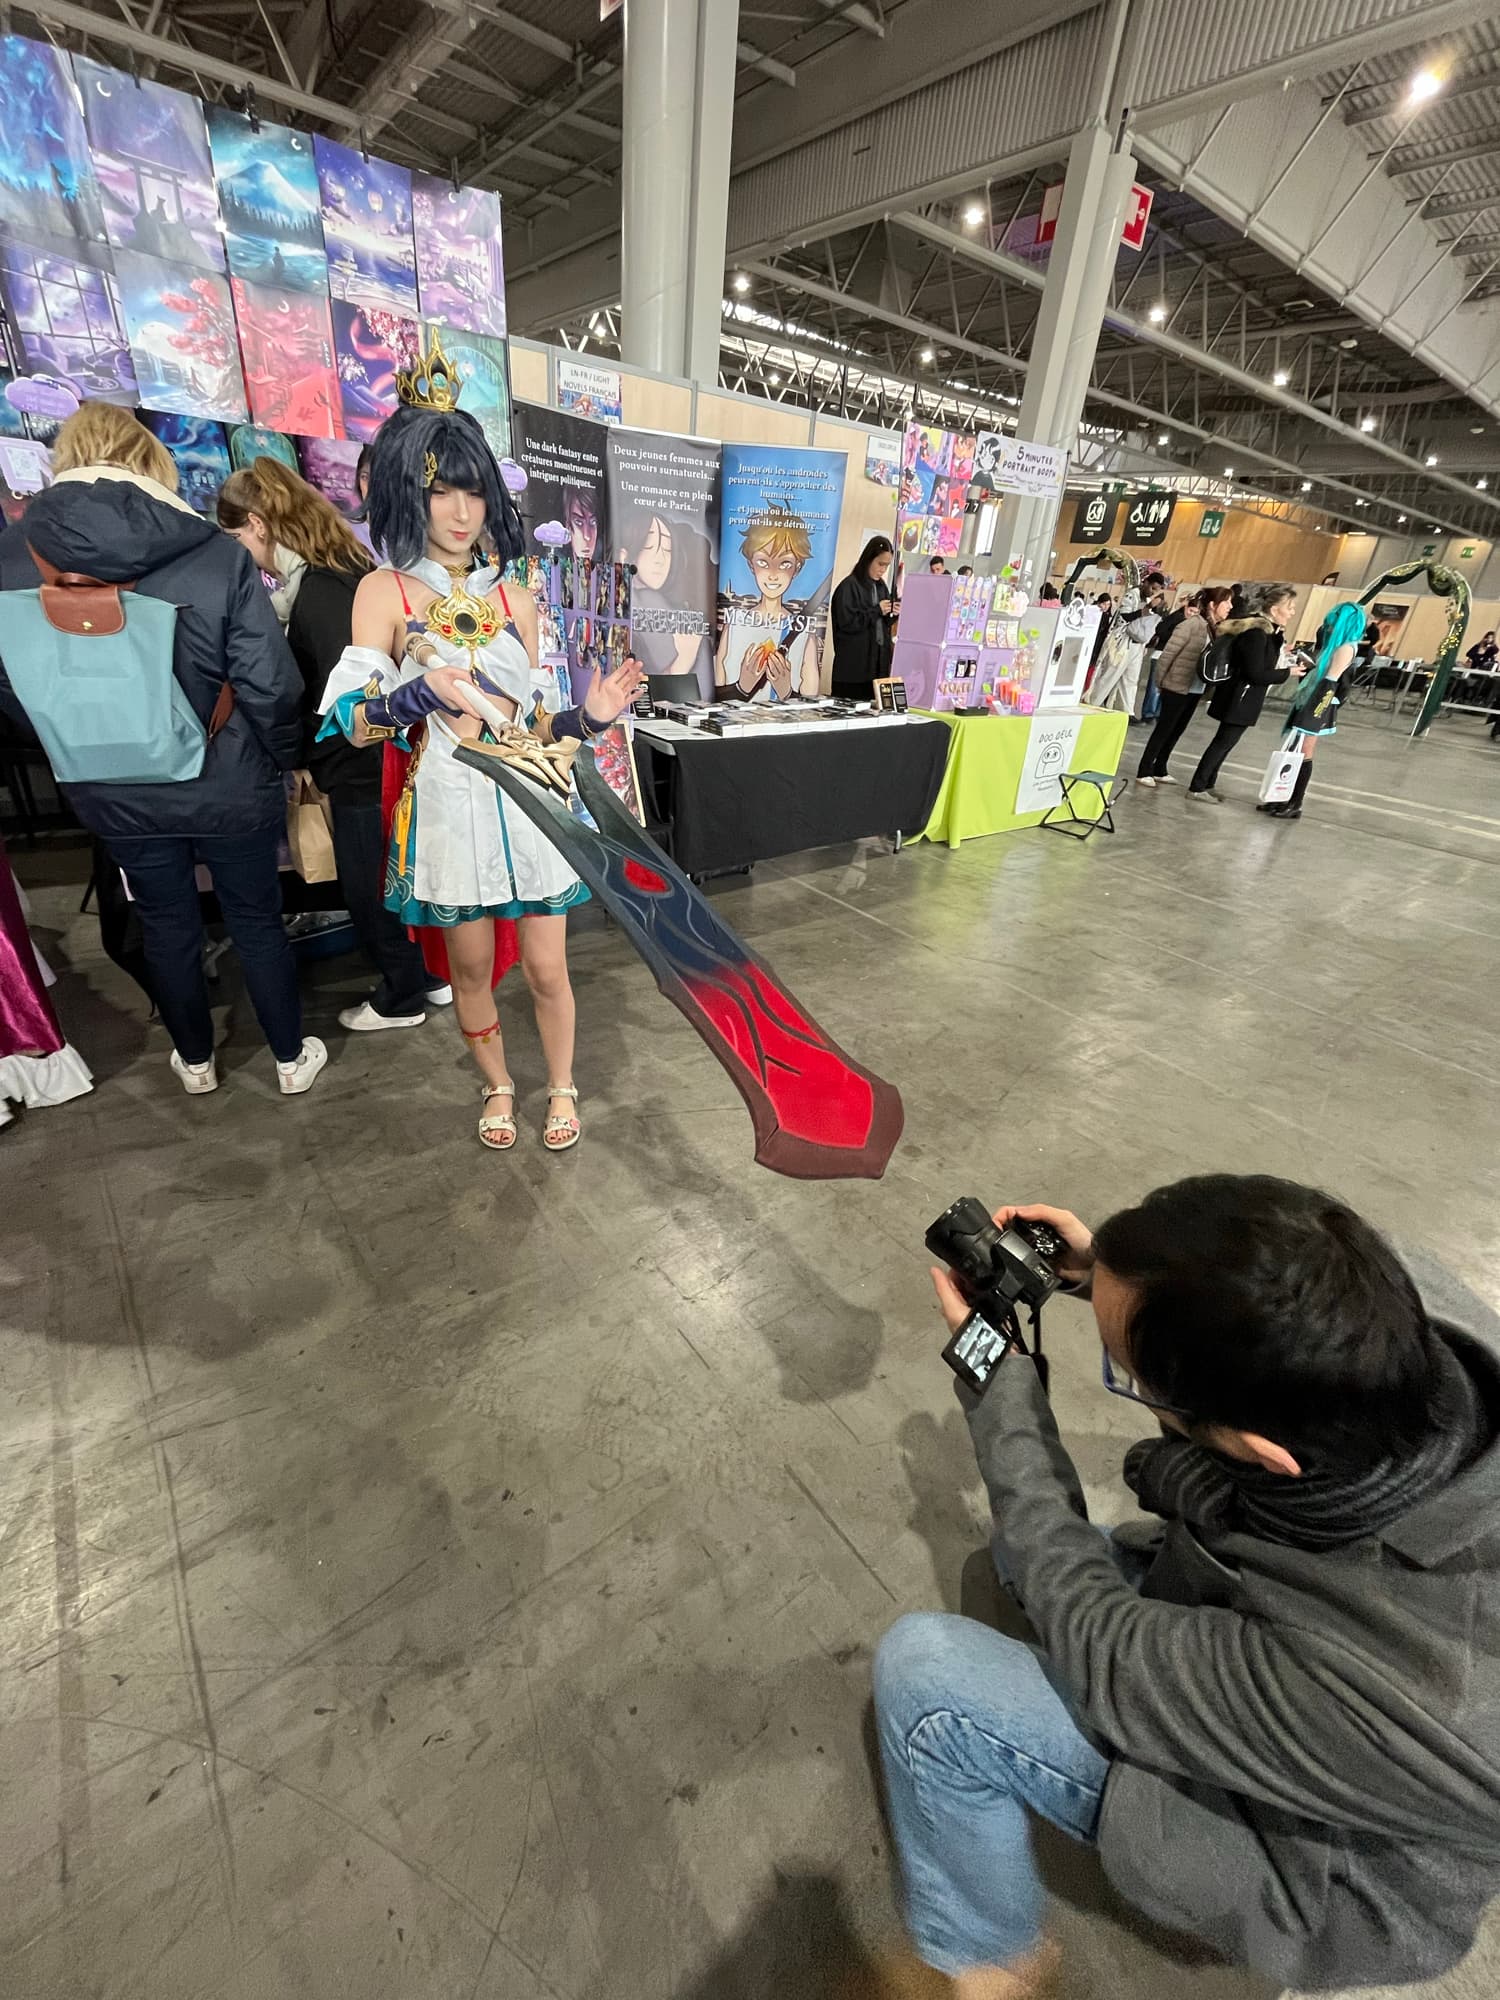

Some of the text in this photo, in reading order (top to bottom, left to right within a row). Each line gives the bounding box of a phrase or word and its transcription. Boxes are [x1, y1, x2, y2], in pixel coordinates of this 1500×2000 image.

[563, 380, 588, 392] NOVELS
[593, 374, 610, 385] LIGHT
[526, 437, 599, 463] Une dark fantasy entre
[614, 444, 720, 469] Deux jeunes femmes aux
[1016, 446, 1025, 461] 5
[521, 452, 603, 478] créatures monstrueuses et
[619, 461, 657, 473] pouvoirs
[775, 466, 786, 475] les
[1002, 460, 1036, 474] PORTRAIT
[1037, 468, 1056, 478] BOOTH
[529, 464, 559, 483] intrigues
[621, 480, 713, 502] Une romance en plein
[728, 476, 772, 487] peuvent-ils
[822, 481, 837, 492] des
[634, 497, 657, 507] cœur
[657, 498, 667, 509] de
[782, 508, 793, 517] les
[794, 509, 831, 520] humains
[729, 517, 772, 527] peuvent-ils
[774, 520, 782, 528] se
[723, 605, 818, 634] MYDRIASE
